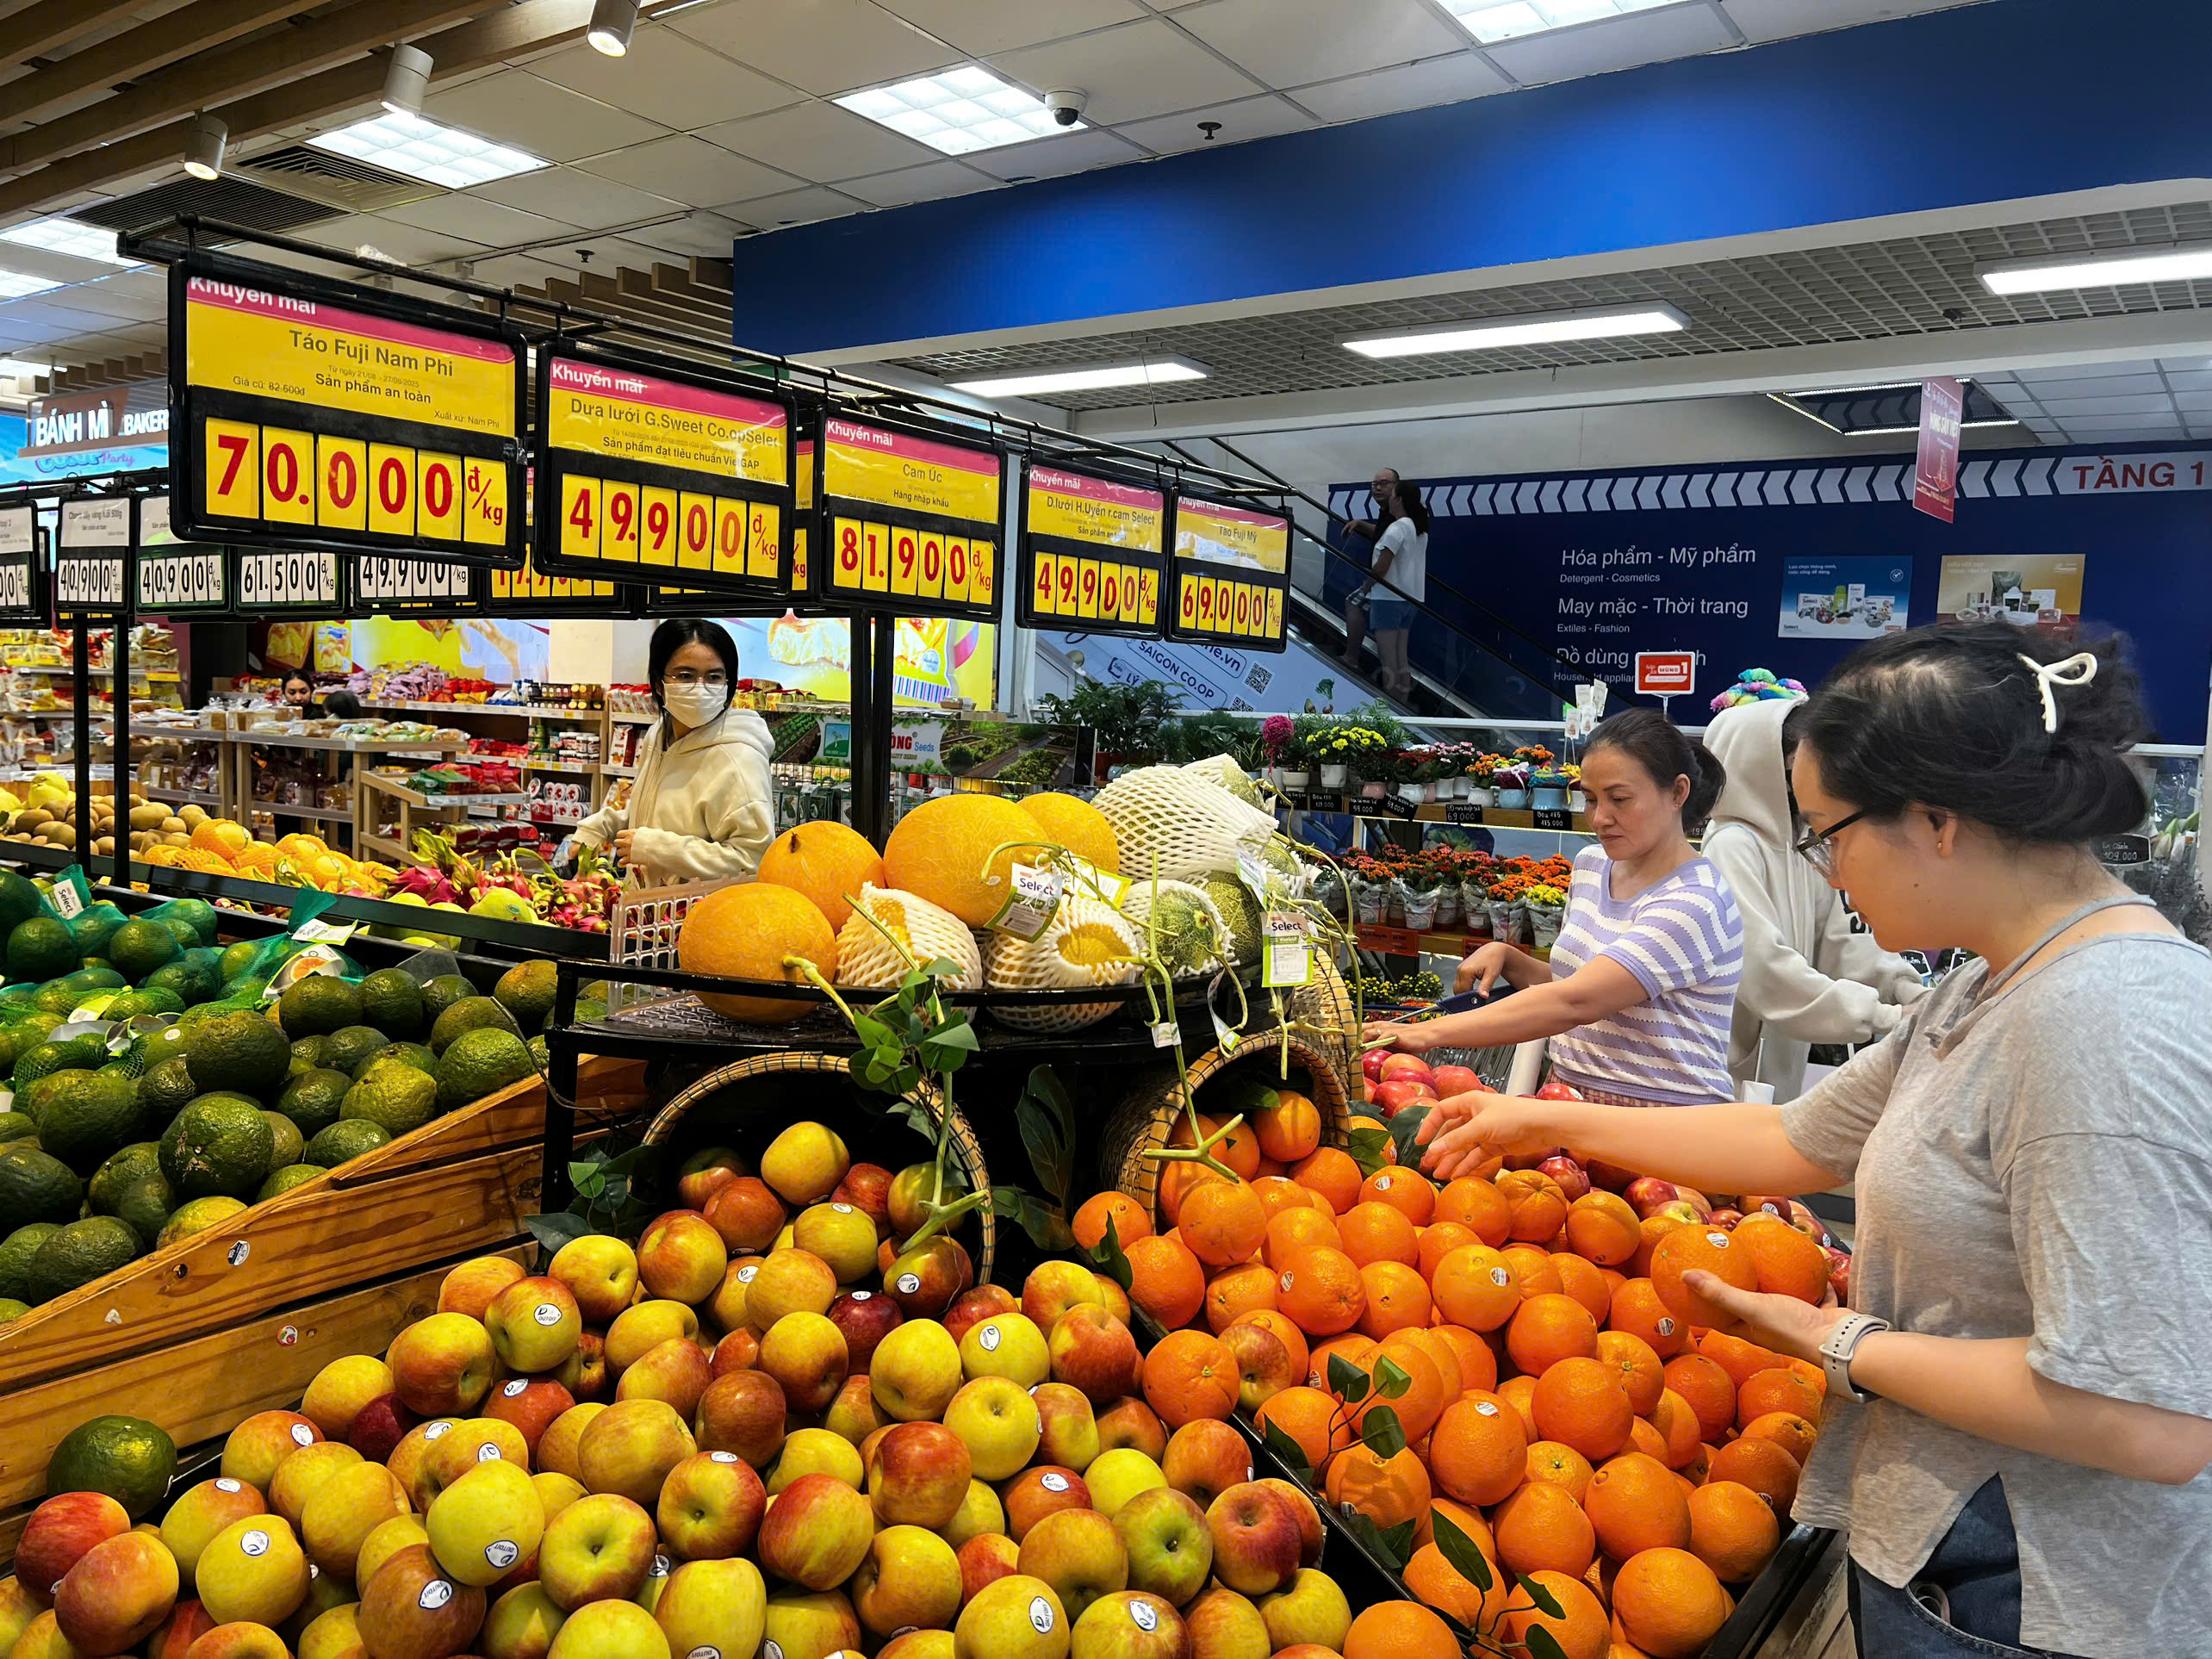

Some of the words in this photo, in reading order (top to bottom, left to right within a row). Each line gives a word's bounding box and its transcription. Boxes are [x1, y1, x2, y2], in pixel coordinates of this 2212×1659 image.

[289, 329, 327, 352] Táo
[334, 339, 369, 363] Fuji
[376, 347, 419, 370] Nam
[425, 357, 454, 377] Phi
[233, 376, 250, 387] Giá
[315, 373, 341, 388] Sản
[345, 379, 382, 395] phẩm
[385, 388, 401, 399] an
[404, 389, 432, 404] toàn
[552, 364, 611, 388] Khuyến
[615, 379, 643, 394] mãi
[35, 407, 83, 446] BÁNH
[88, 400, 109, 440] MÌ
[468, 417, 486, 426] Nam
[488, 419, 500, 428] Phi
[571, 398, 604, 417] Dưa
[609, 405, 640, 424] lưới
[645, 411, 704, 435] G.Sweet
[827, 420, 870, 442] Khuyến
[873, 432, 893, 446] mãi
[603, 436, 623, 449] Sản
[625, 440, 653, 453] phẩm
[656, 445, 672, 458] đạt
[674, 447, 692, 460] tiêu
[694, 450, 722, 463] chuẩn
[217, 433, 453, 517] 70.000
[903, 463, 925, 480] Cam
[929, 467, 942, 483] Úc
[1029, 469, 1063, 487] Khuyến
[2072, 455, 2176, 490] TẦNG
[2190, 461, 2203, 486] 1
[894, 488, 912, 502] Hàng
[914, 494, 930, 506] nhập
[933, 495, 949, 508] khẩu
[1047, 495, 1073, 511] D.lưới
[1076, 500, 1106, 518] H.Uyển
[1108, 507, 1130, 521] r.cam
[1132, 511, 1155, 525] Select
[569, 488, 741, 558] 49.900
[1078, 525, 1089, 535] Sản
[1090, 527, 1105, 537] phẩm
[1233, 528, 1246, 542] Fuji
[841, 526, 966, 584] 81.900
[1562, 550, 1597, 566] Hóa
[1602, 545, 1652, 569] phẩm
[1669, 547, 1698, 568] Mỹ
[1702, 543, 1756, 568] phẩm
[59, 564, 110, 593] 40.900
[142, 561, 204, 595] 40.900
[244, 558, 316, 594] 61.500
[1038, 562, 1135, 612] 49.900
[1560, 574, 1604, 584] Detergent
[1612, 573, 1661, 582] Cosmetics
[1183, 584, 1262, 627] 69.000
[1558, 598, 1594, 618] May
[1599, 598, 1637, 618] mặc
[1652, 597, 1694, 614] Thời
[1700, 599, 1749, 618] trang
[1556, 624, 1587, 633] Extiles
[1594, 624, 1631, 633] Fashion
[1138, 640, 1180, 676] SAIGON
[1180, 671, 1215, 699] CO.OP
[1585, 649, 1629, 668] dùng
[915, 742, 935, 752] Seeds
[59, 889, 74, 913] Select
[1271, 922, 1302, 931] Select
[494, 1544, 515, 1553] DUTOIT
[423, 1581, 443, 1599] DUTOIT
